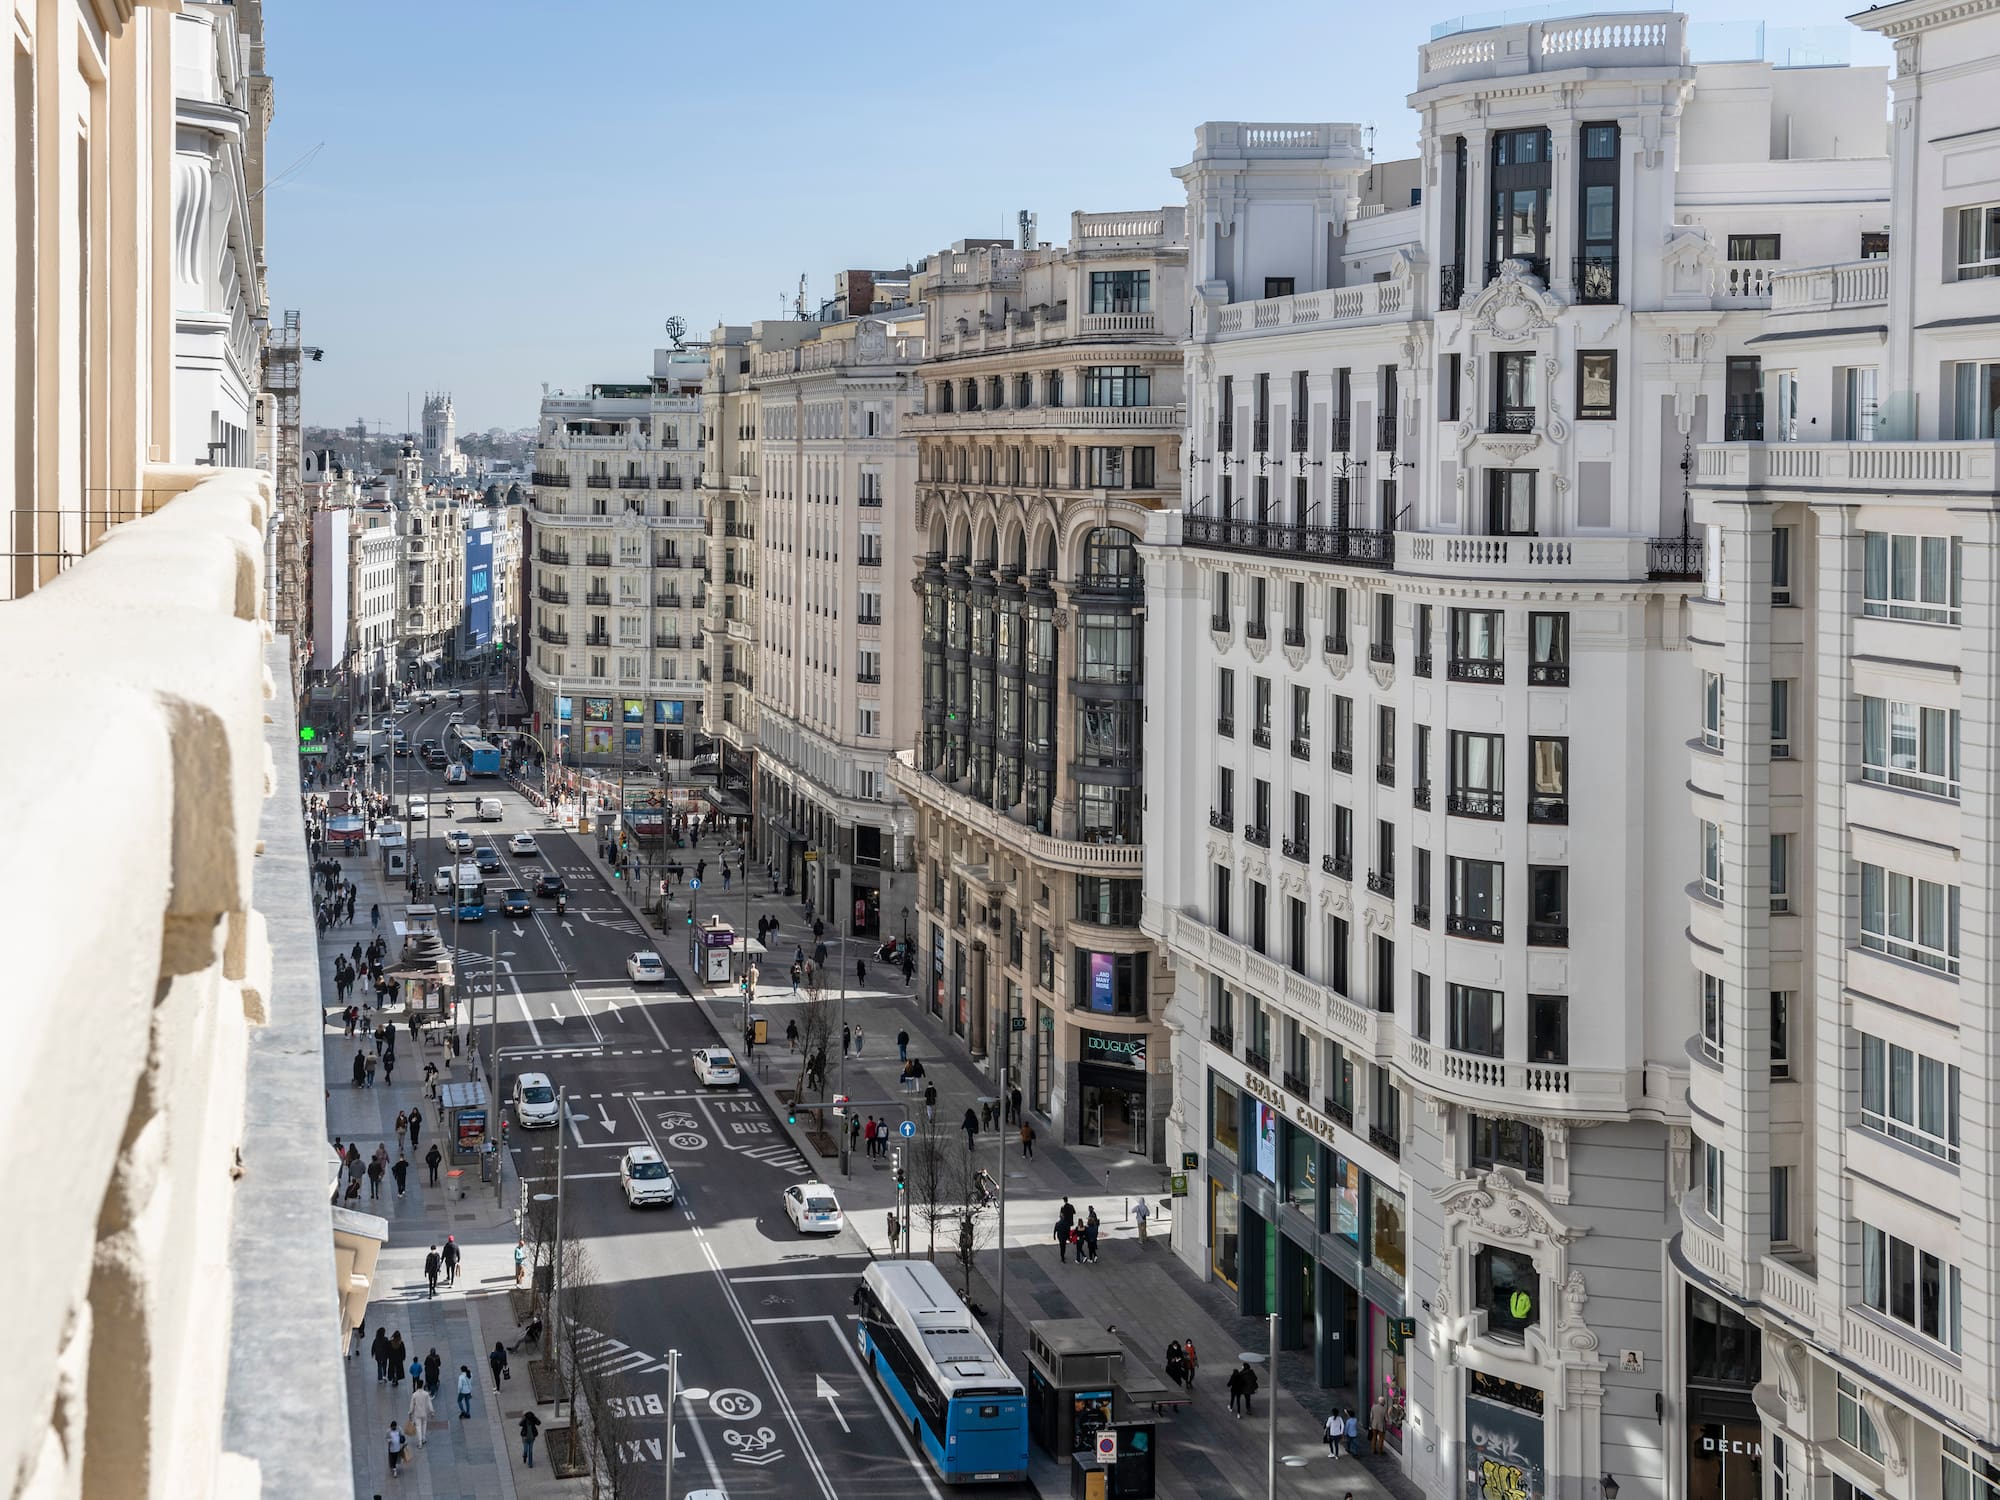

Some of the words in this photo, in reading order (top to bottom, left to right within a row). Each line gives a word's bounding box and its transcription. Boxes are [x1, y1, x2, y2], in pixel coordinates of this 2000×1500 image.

[472, 571, 487, 594] NADA
[466, 984, 505, 993] TAXI
[1088, 1037, 1136, 1054] DOUGLAS
[714, 1101, 762, 1113] TAXI
[1245, 1072, 1287, 1112] ESPASA
[1296, 1106, 1335, 1144] CALPE
[730, 1122, 773, 1134] BUS
[678, 1136, 699, 1146] 30
[607, 1393, 665, 1418] BUS
[721, 1396, 751, 1413] 30
[615, 1438, 686, 1464] TAXI
